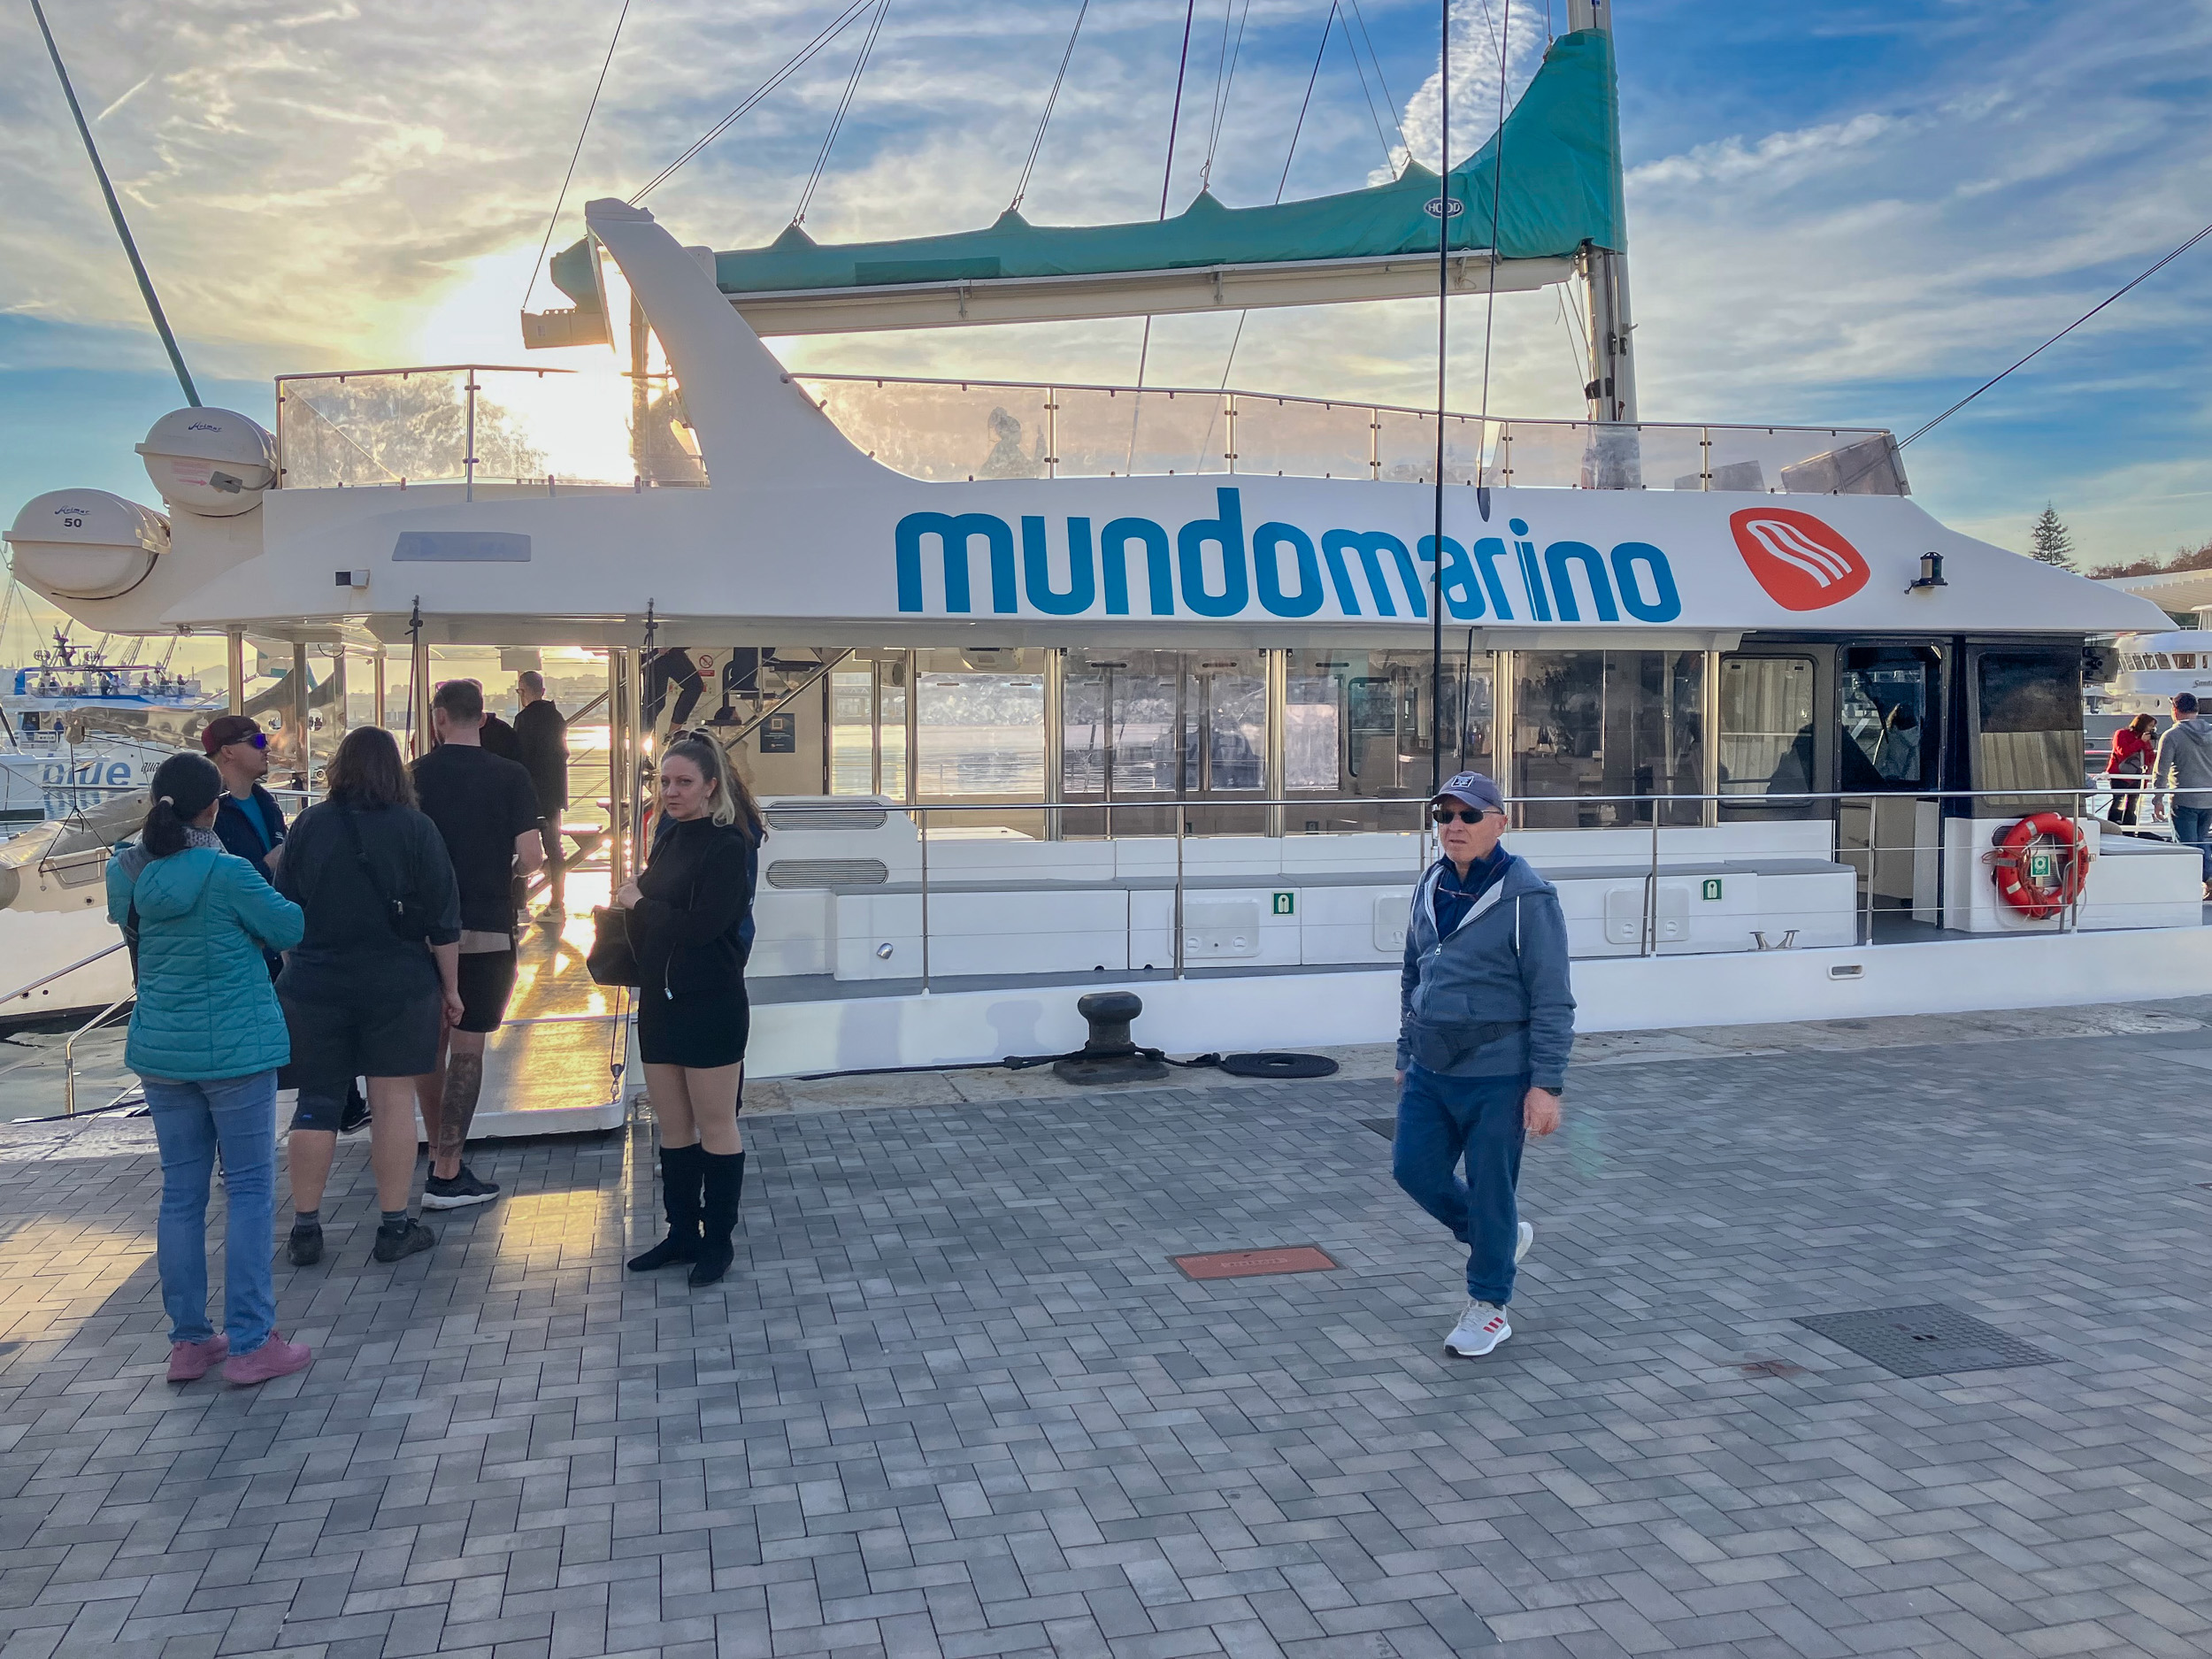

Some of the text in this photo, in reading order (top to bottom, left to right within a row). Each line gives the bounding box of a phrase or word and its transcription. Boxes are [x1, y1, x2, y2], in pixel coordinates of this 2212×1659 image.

[1427, 202, 1461, 213] HOOD
[64, 518, 82, 528] 50
[895, 487, 1681, 622] mundomarino
